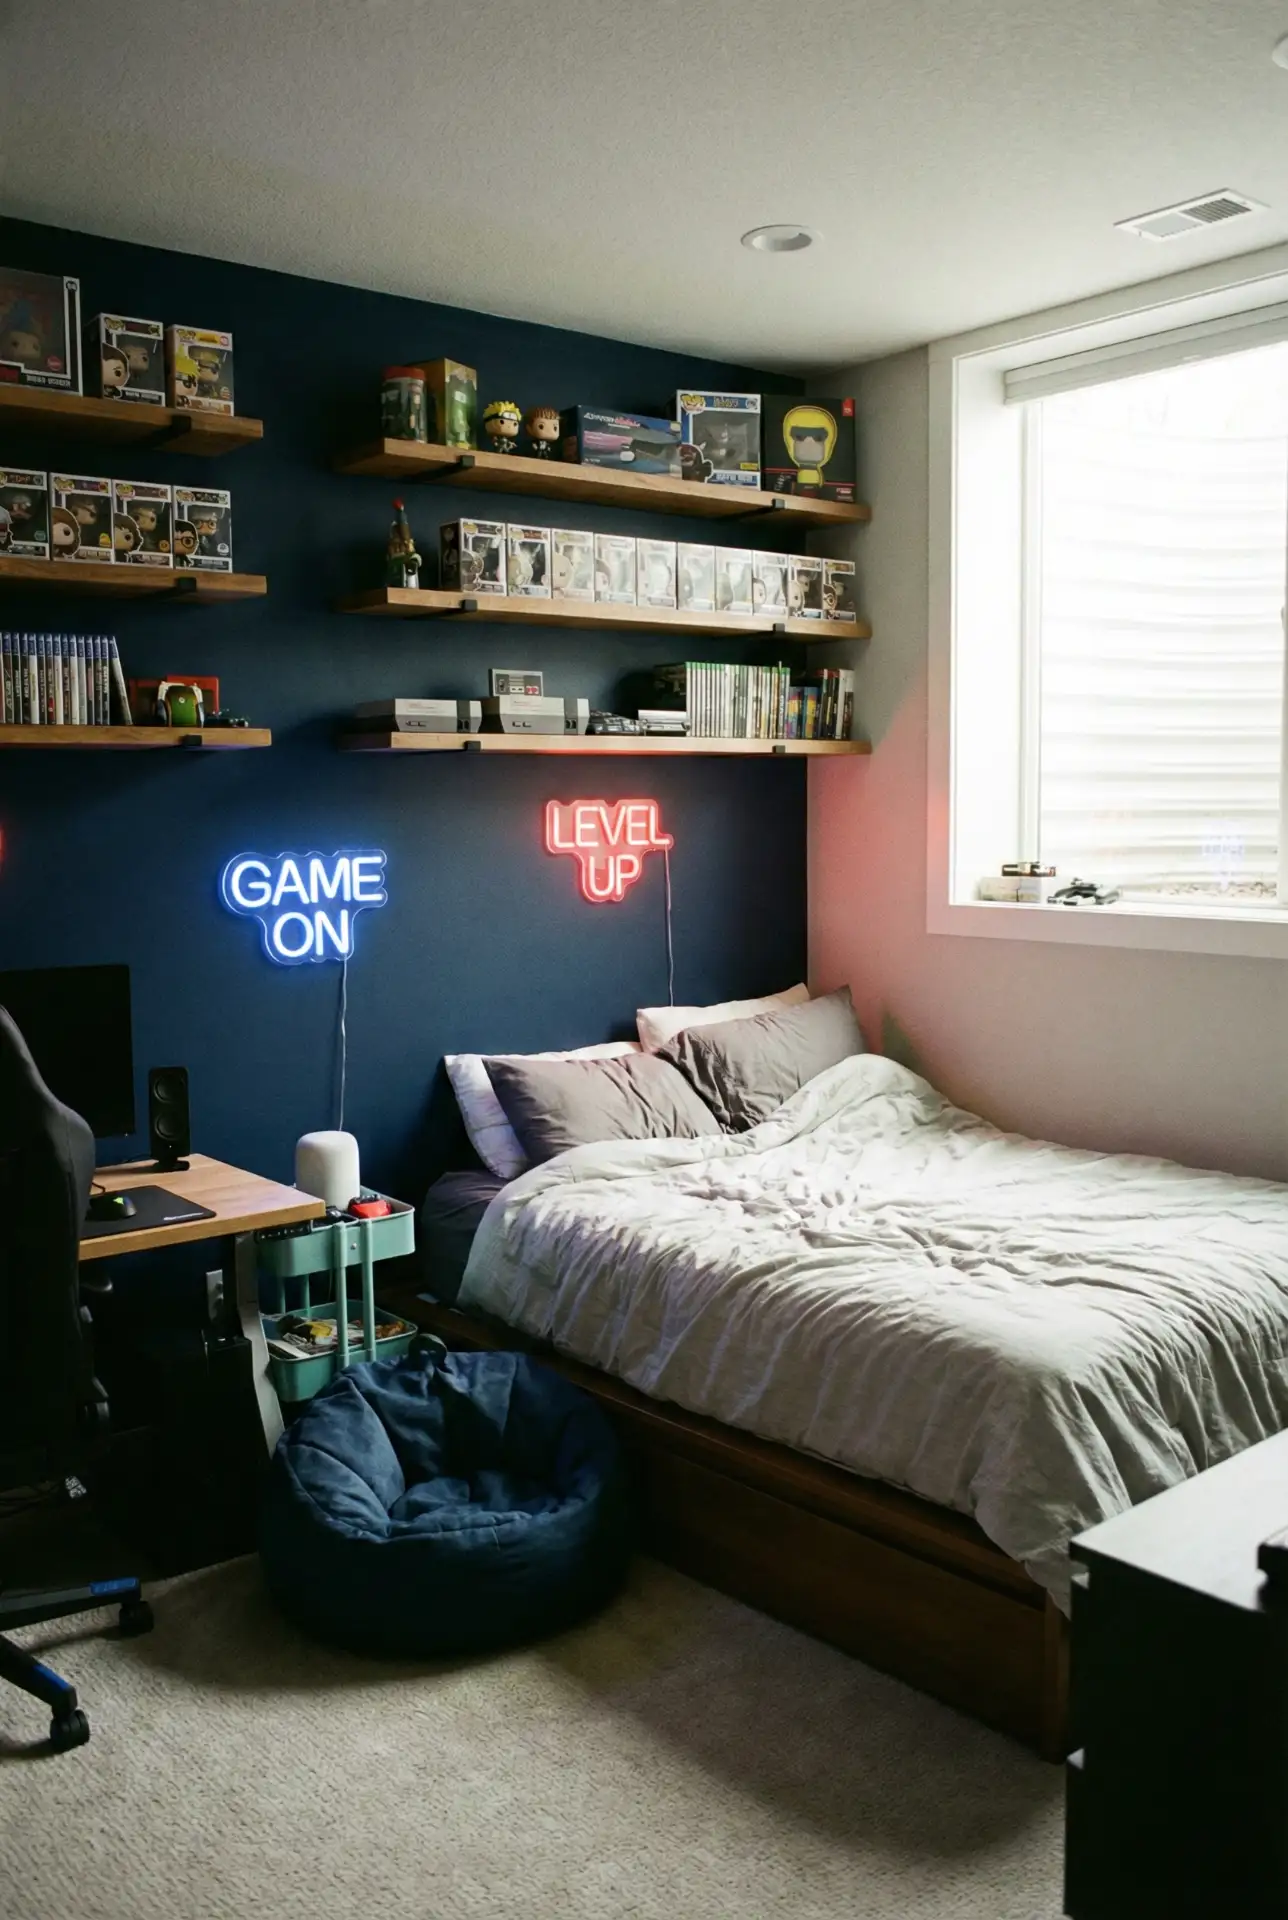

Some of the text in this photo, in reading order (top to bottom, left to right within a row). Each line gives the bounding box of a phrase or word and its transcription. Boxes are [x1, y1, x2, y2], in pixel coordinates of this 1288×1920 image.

[552, 804, 671, 849] LEVEL
[230, 856, 383, 908] GAME
[586, 853, 641, 897] UP
[272, 909, 350, 958] ON
